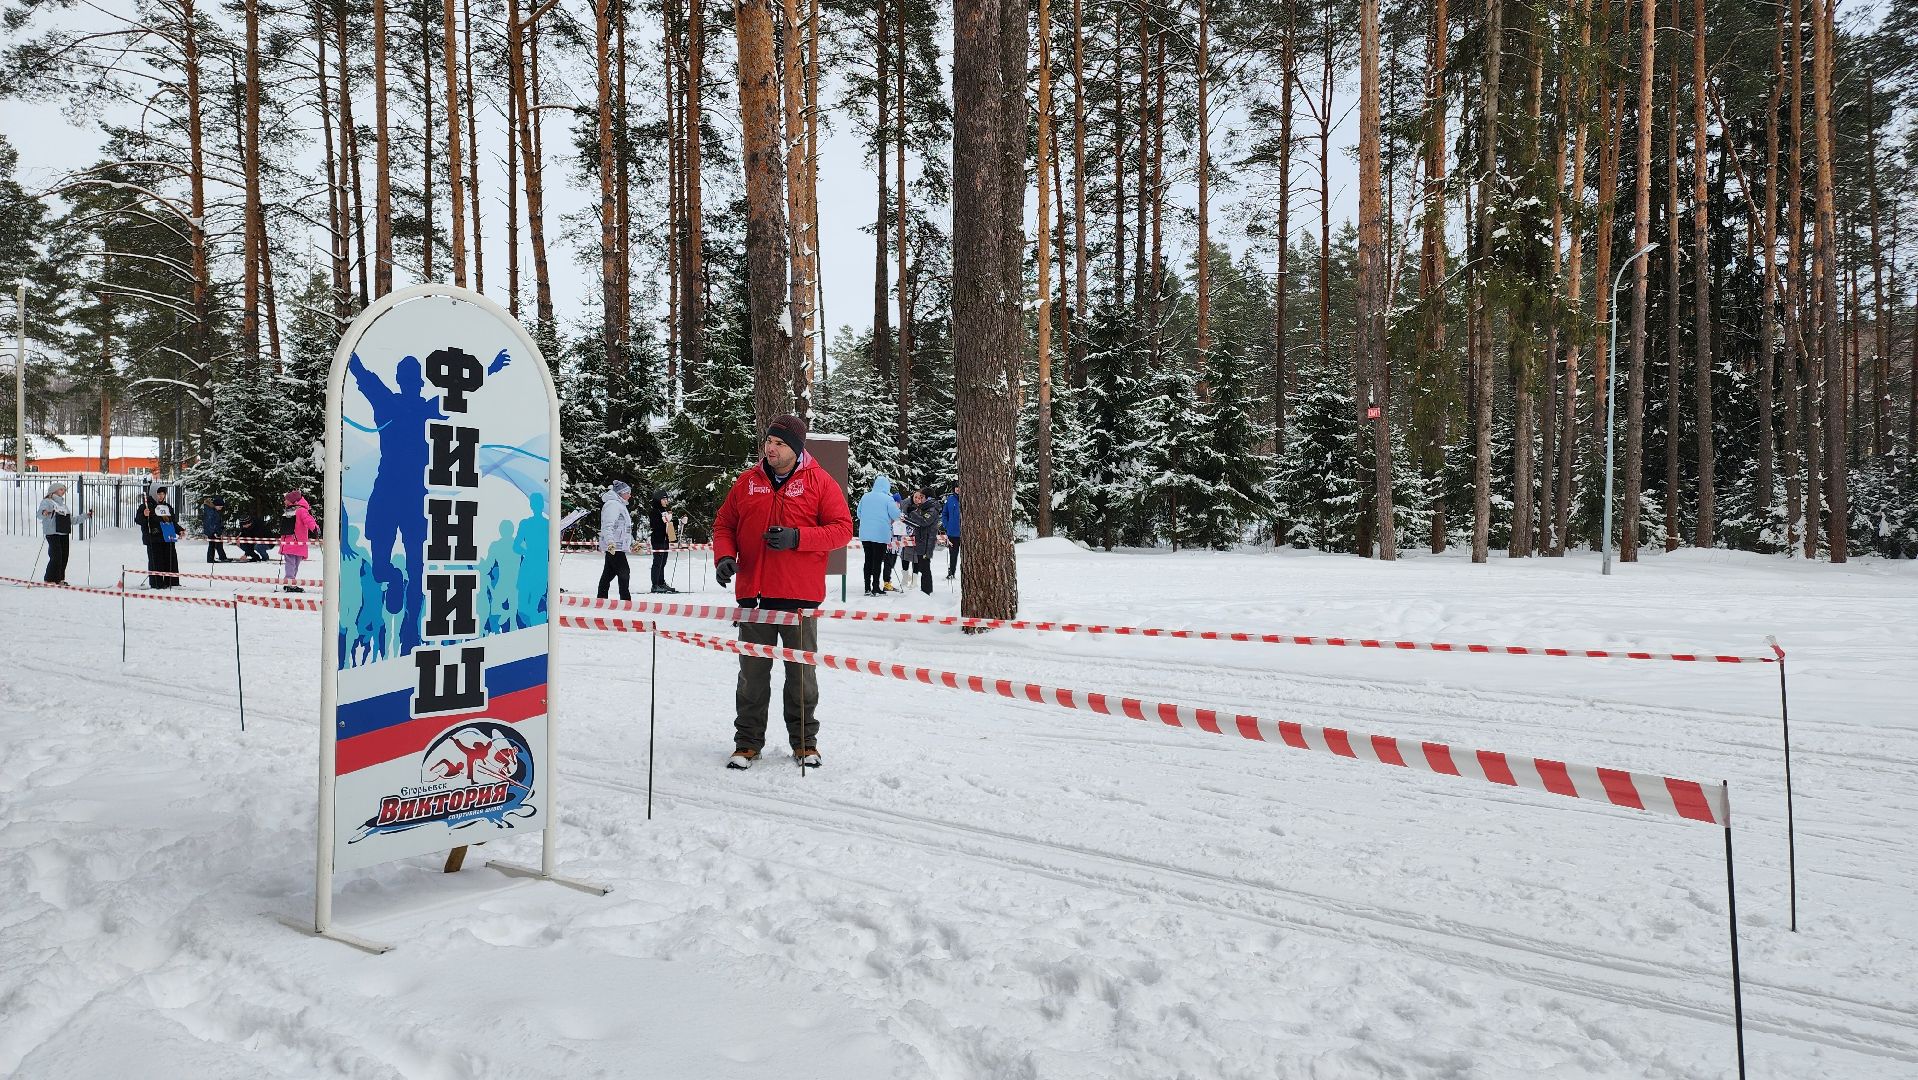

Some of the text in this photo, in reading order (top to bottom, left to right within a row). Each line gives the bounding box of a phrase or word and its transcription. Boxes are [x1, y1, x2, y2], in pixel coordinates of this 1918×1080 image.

[414, 346, 485, 715] ФИНИШ
[377, 782, 509, 825] ВИКТОРИЯ
[400, 782, 448, 797] Егорьевск
